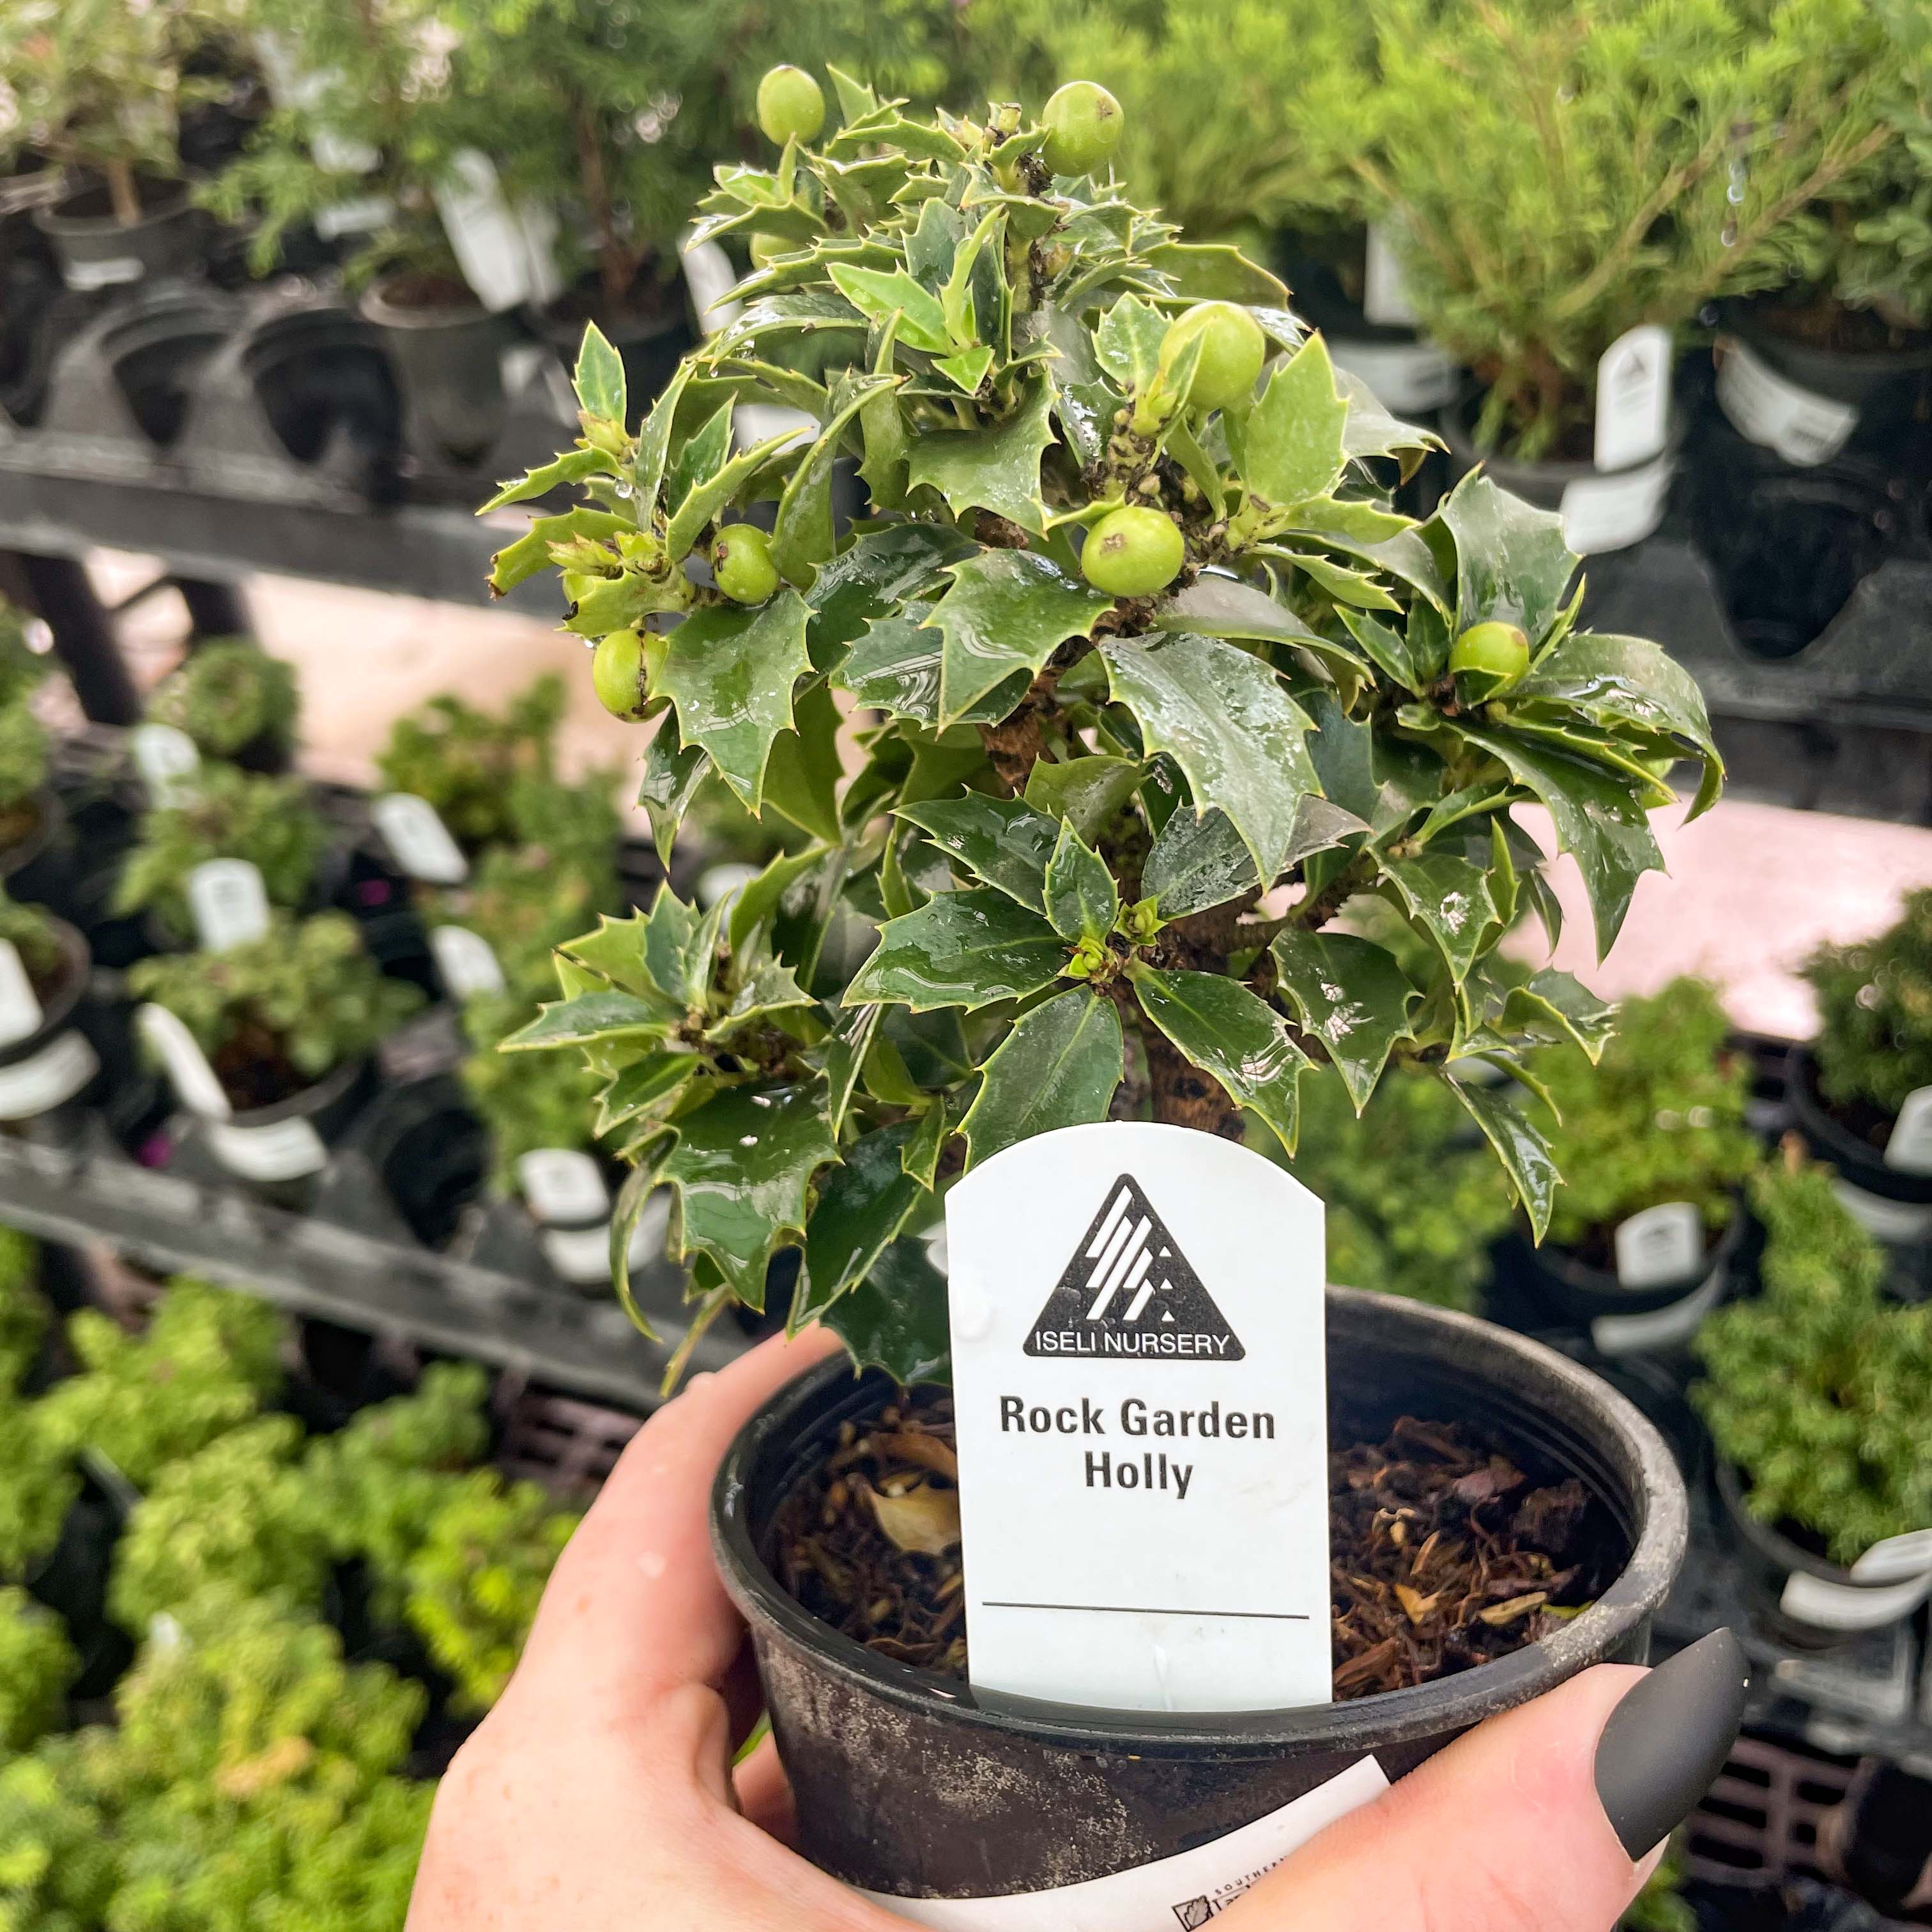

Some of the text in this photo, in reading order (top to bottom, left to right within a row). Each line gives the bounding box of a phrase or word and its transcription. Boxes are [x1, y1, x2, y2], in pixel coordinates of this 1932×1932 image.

[1034, 1331, 1230, 1355] ISELI NURSERY
[1000, 1395, 1275, 1439] Rock Garden
[1084, 1451, 1193, 1500] Holly
[1215, 1855, 1287, 1895] SOUTHER
